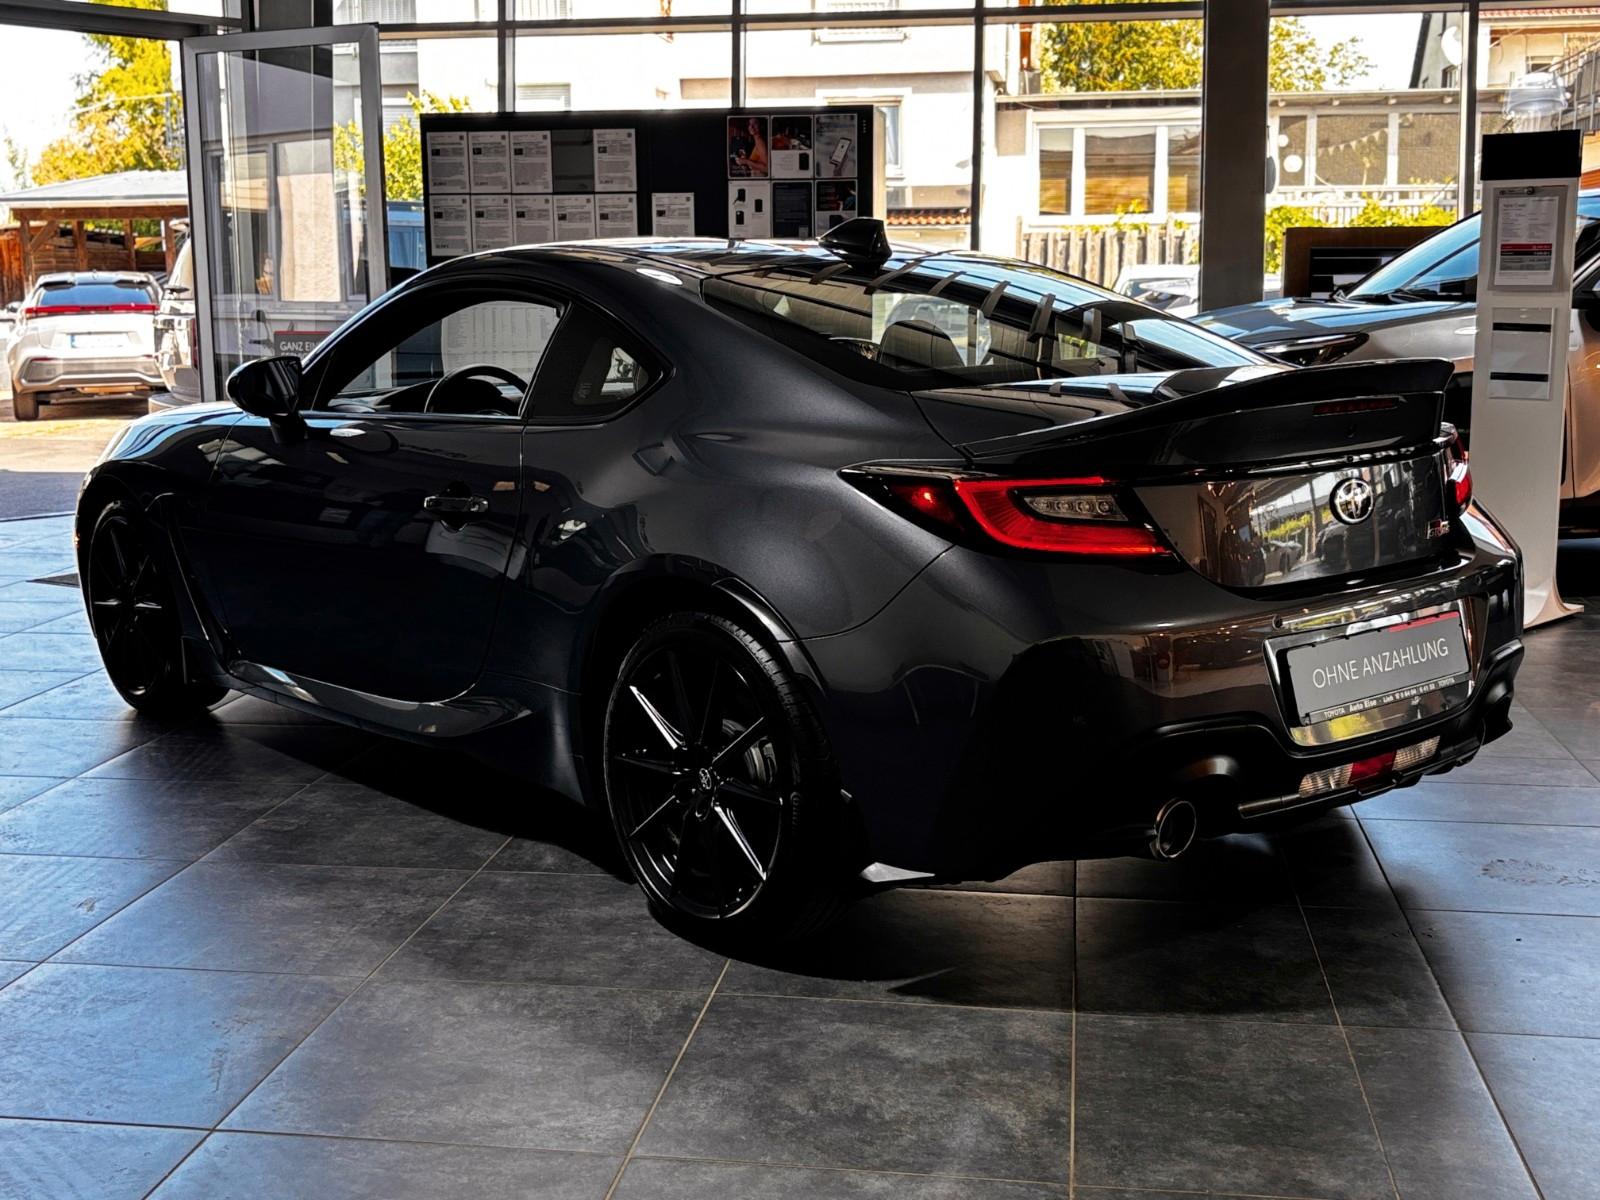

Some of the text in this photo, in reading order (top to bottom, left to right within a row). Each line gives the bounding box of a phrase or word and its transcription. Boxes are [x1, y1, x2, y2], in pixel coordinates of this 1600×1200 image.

[280, 341, 304, 351] GANZ
[1312, 638, 1449, 688] OHNE ANZAHLUNG
[1323, 707, 1346, 719] TOYOTA
[1349, 703, 1364, 712] Auto
[1438, 677, 1456, 688] TOYOTA
